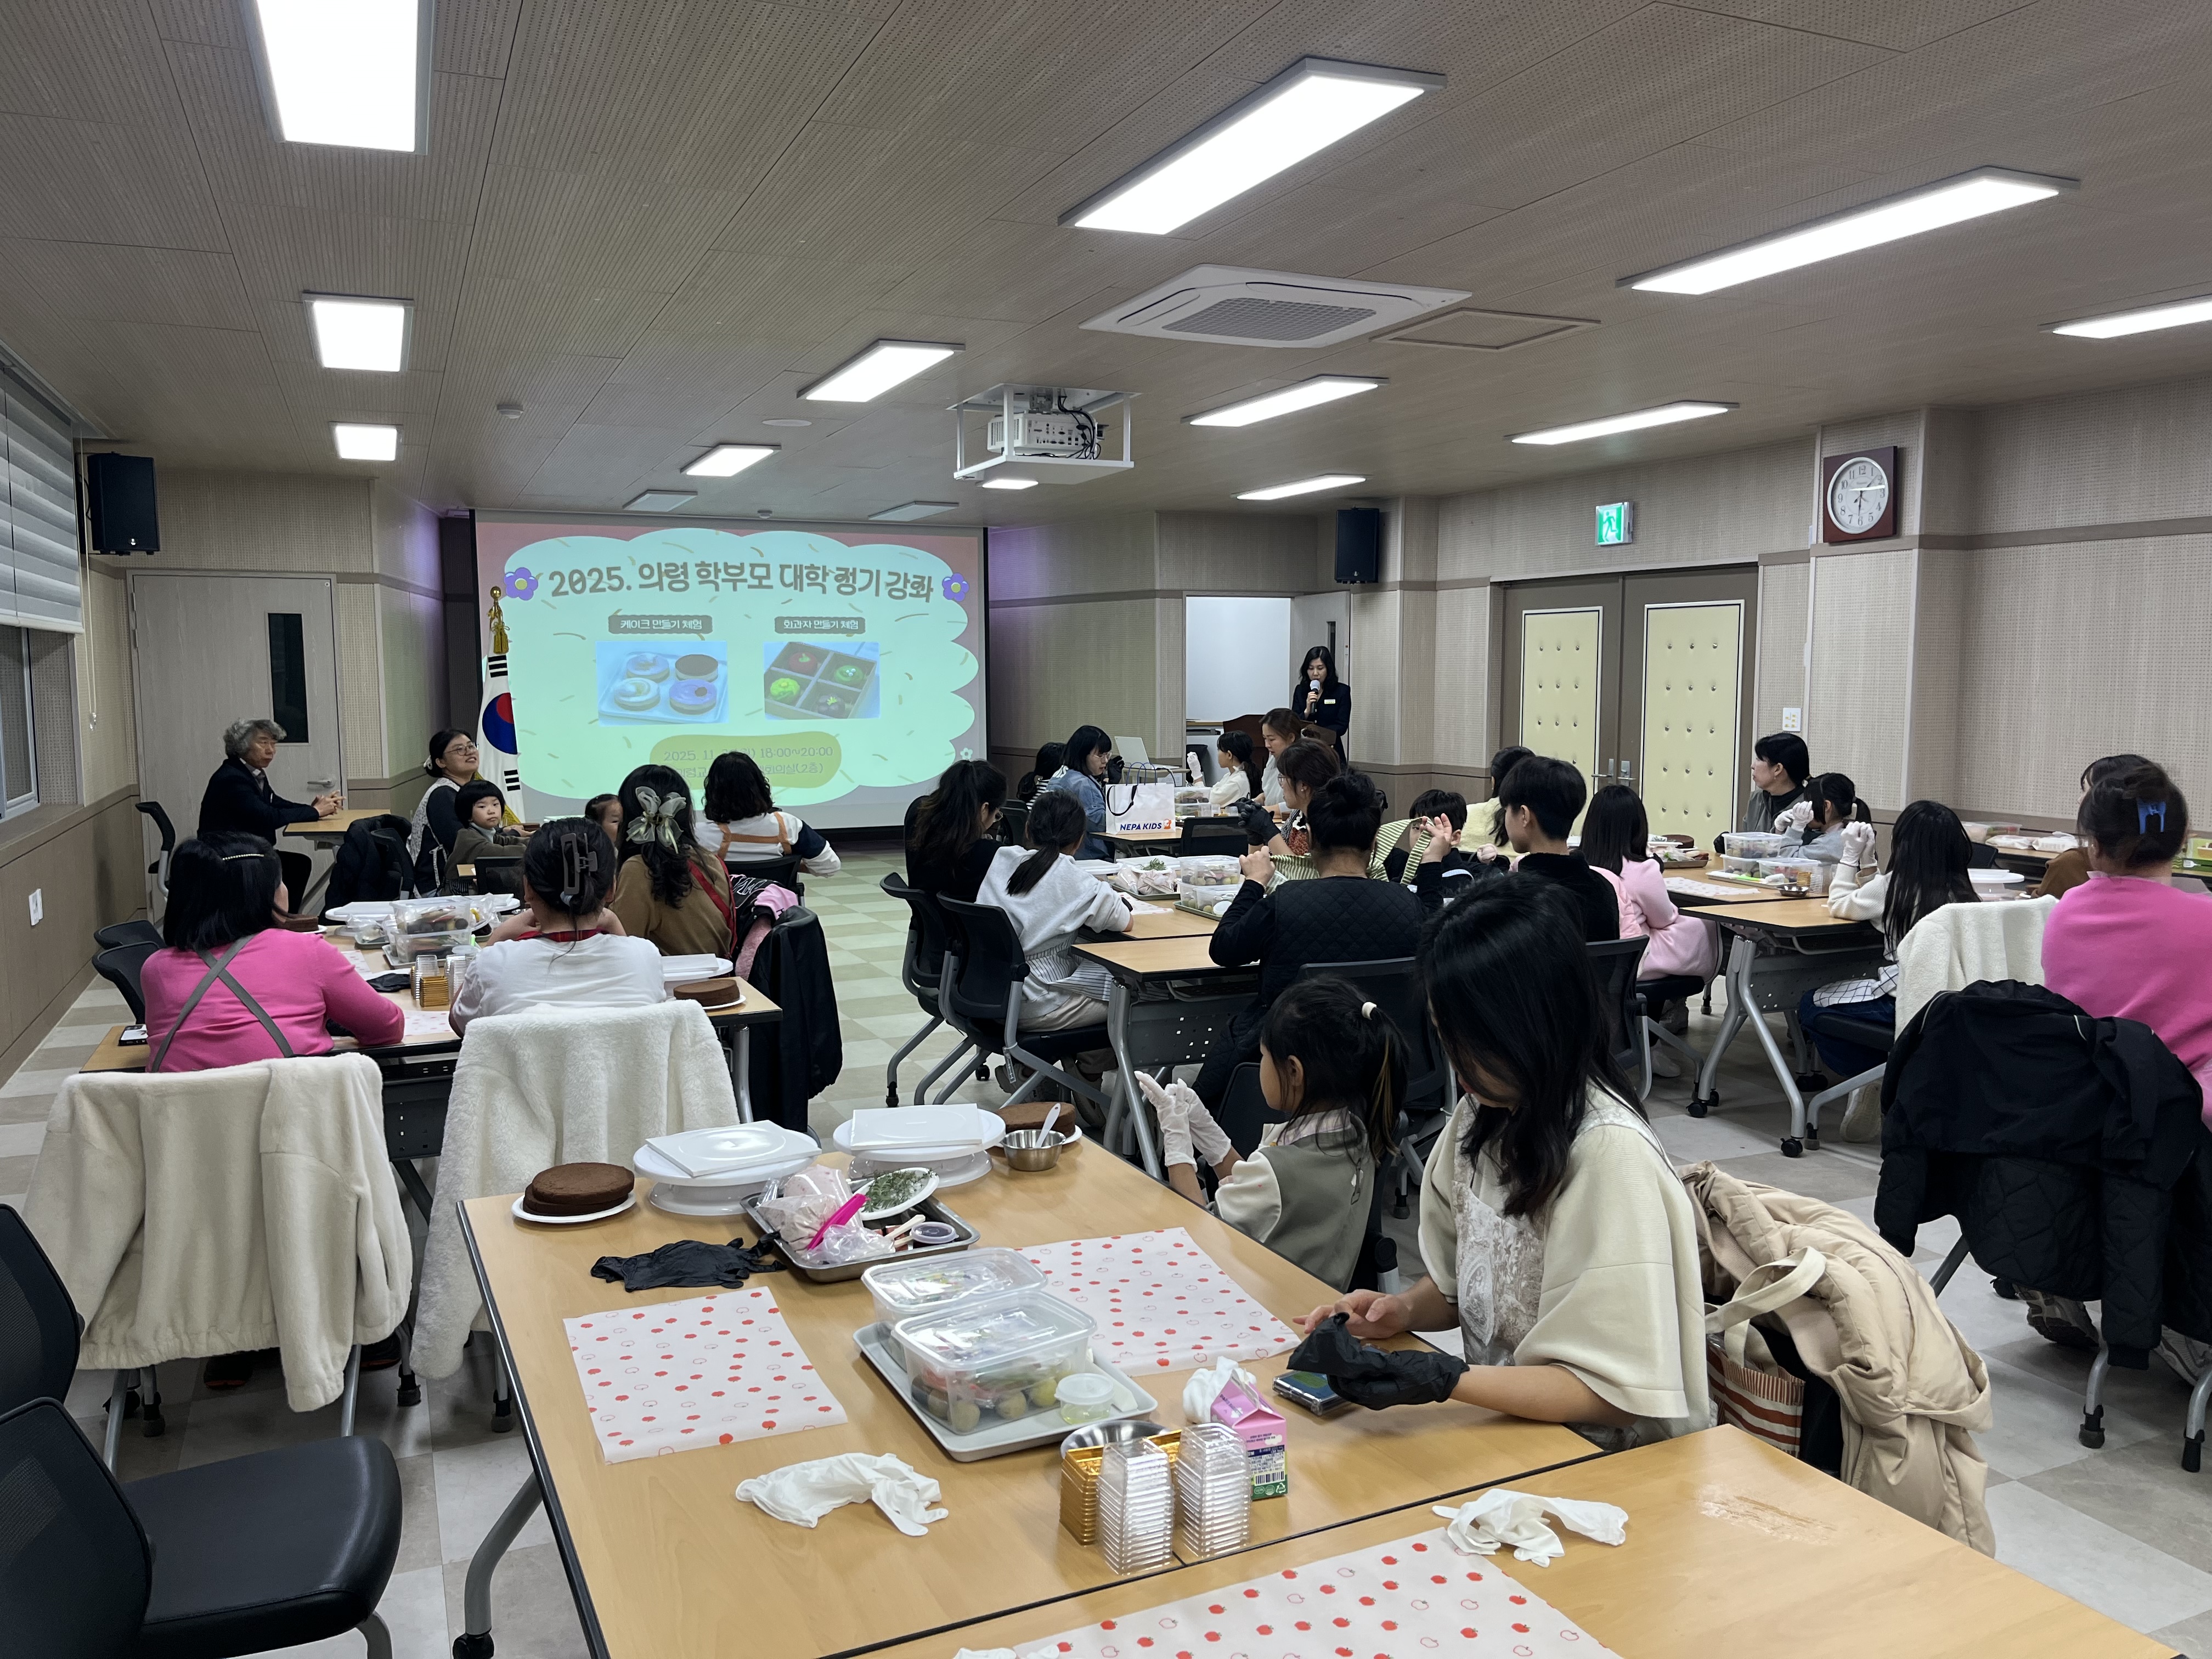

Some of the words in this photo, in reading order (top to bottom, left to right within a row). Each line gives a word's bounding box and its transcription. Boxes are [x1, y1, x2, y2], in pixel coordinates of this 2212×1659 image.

[549, 566, 632, 597] 2025.
[638, 562, 690, 592] 의령
[695, 561, 774, 592] 학부모
[779, 563, 830, 595] 대학
[885, 572, 934, 603] 강좌
[620, 619, 650, 629] 케이크
[652, 619, 680, 630] 만들기
[682, 619, 702, 630] 체험
[783, 620, 812, 629] 화과자
[814, 620, 838, 630] 만들기
[840, 620, 859, 630] 체험
